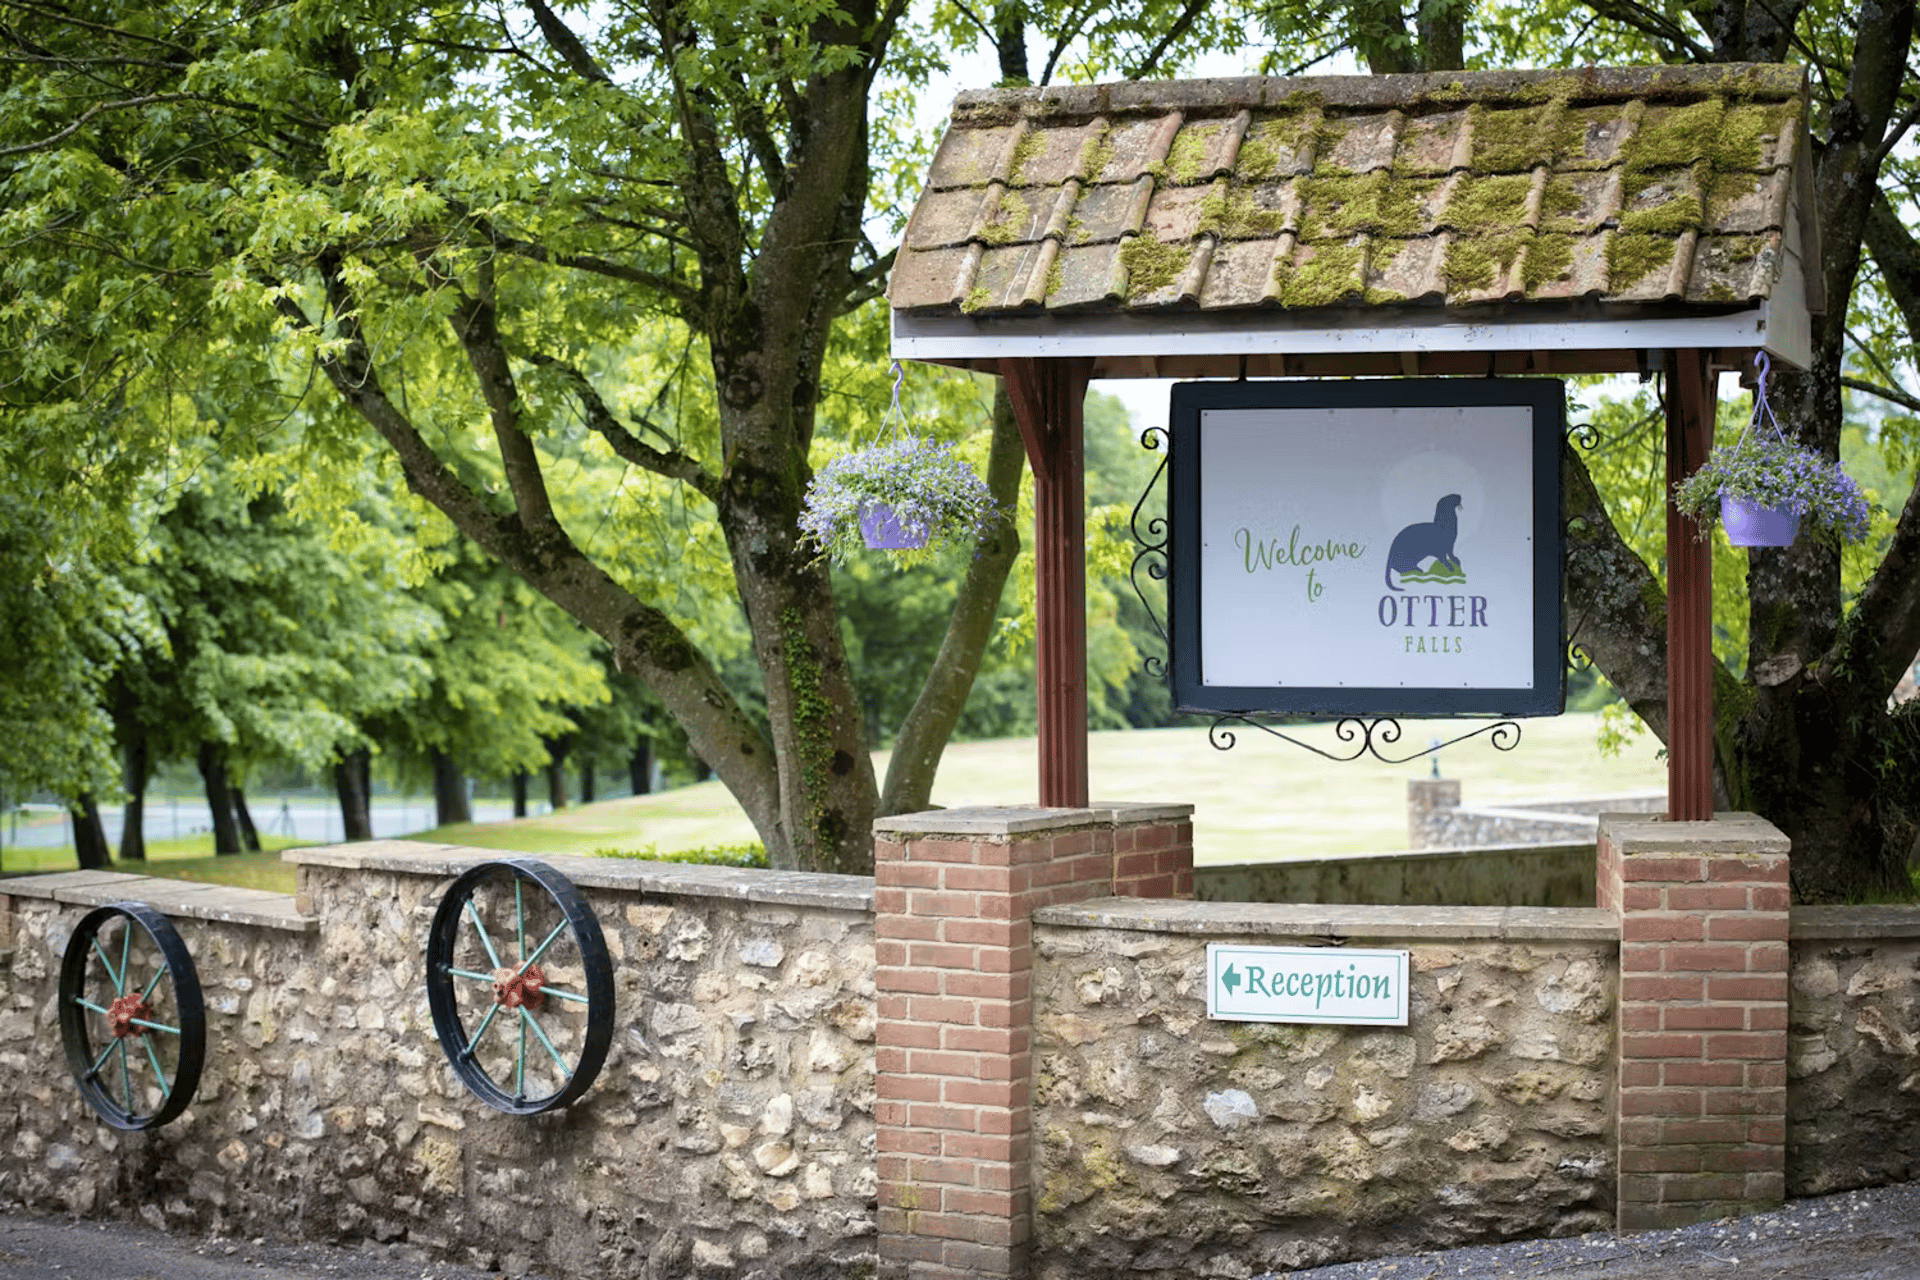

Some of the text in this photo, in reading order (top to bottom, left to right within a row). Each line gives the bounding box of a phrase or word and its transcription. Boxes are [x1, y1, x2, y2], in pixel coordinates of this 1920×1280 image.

[1234, 524, 1366, 573] Welcome
[1305, 568, 1325, 602] to
[1378, 595, 1489, 627] OTTER
[1404, 635, 1463, 654] FALLS
[1244, 963, 1391, 1010] Reception
